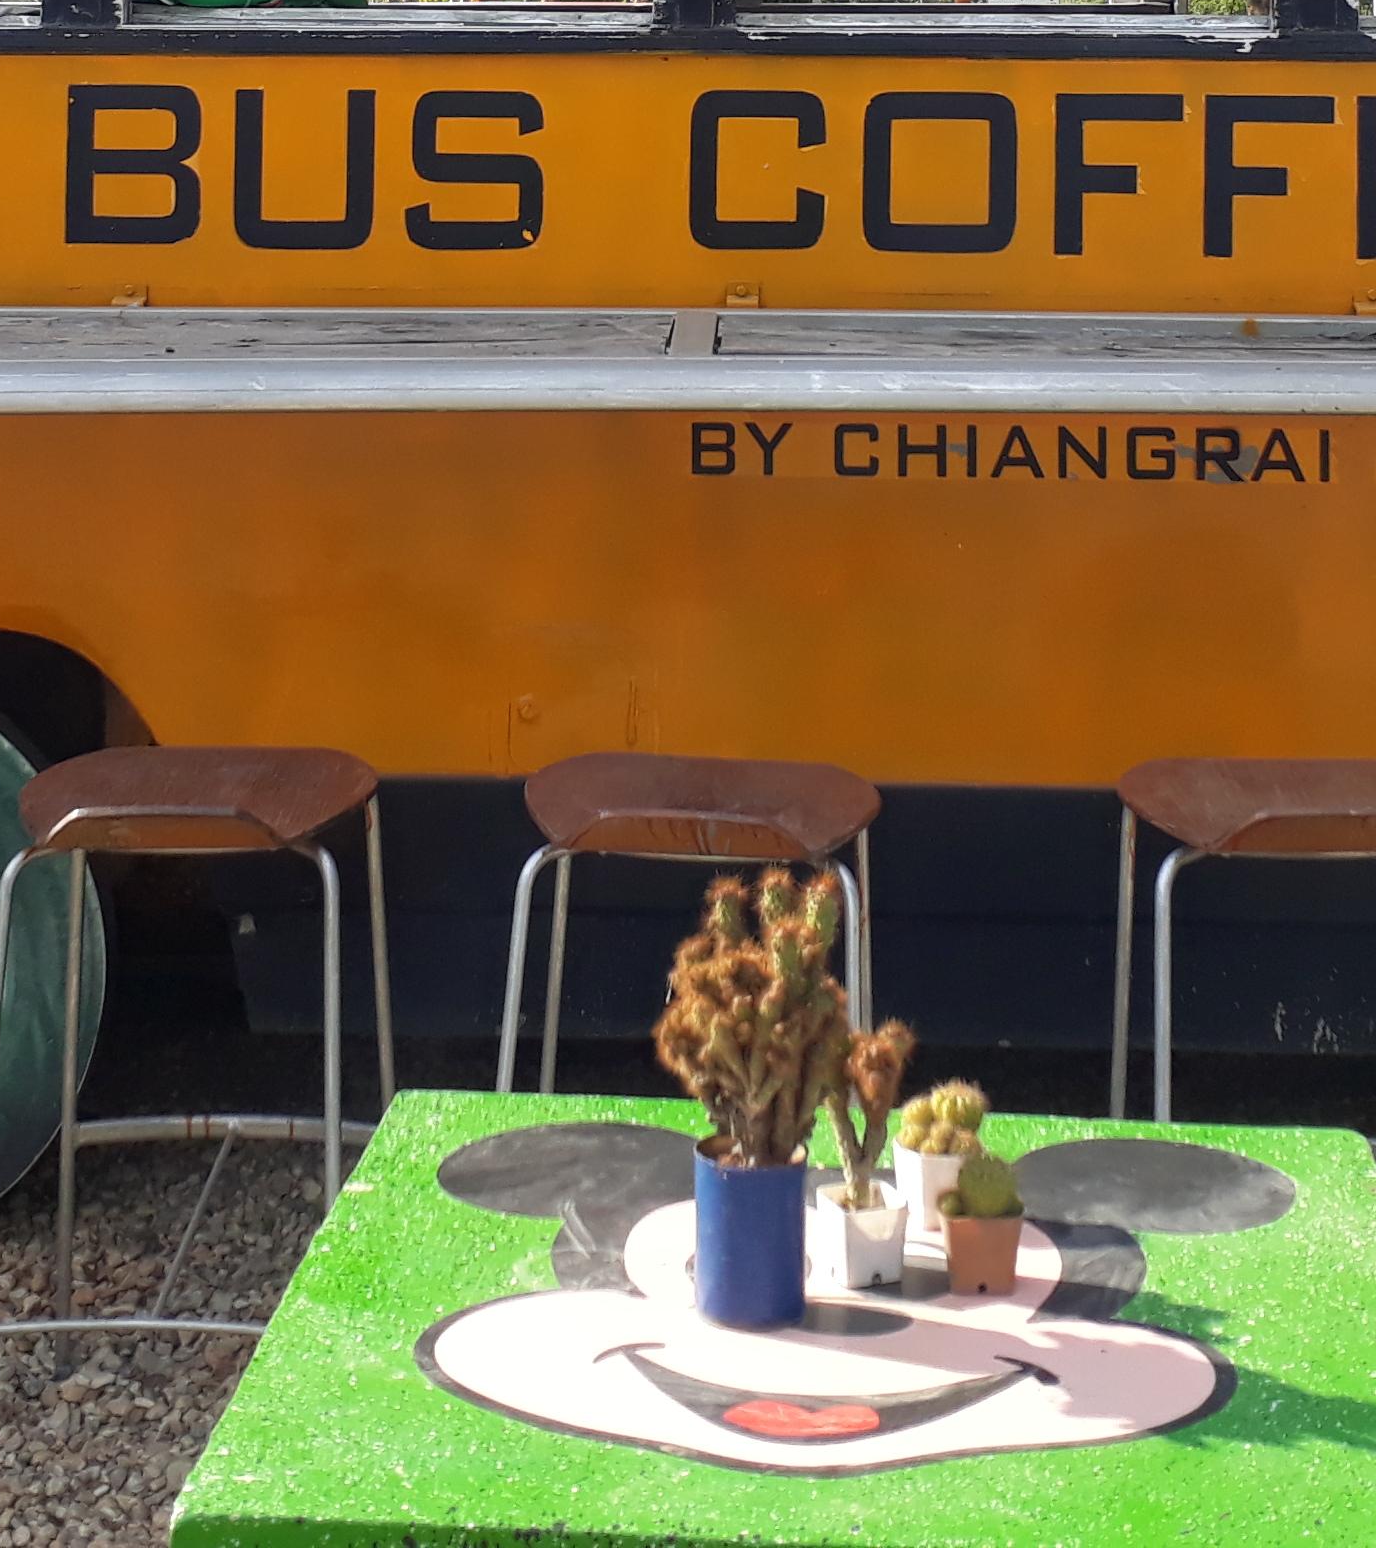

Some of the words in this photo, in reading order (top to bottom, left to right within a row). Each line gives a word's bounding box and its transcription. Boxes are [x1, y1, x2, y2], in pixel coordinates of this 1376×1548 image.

[65, 84, 544, 250] BUS
[691, 421, 793, 477] BY
[833, 423, 1331, 484] CHIANGRAI
